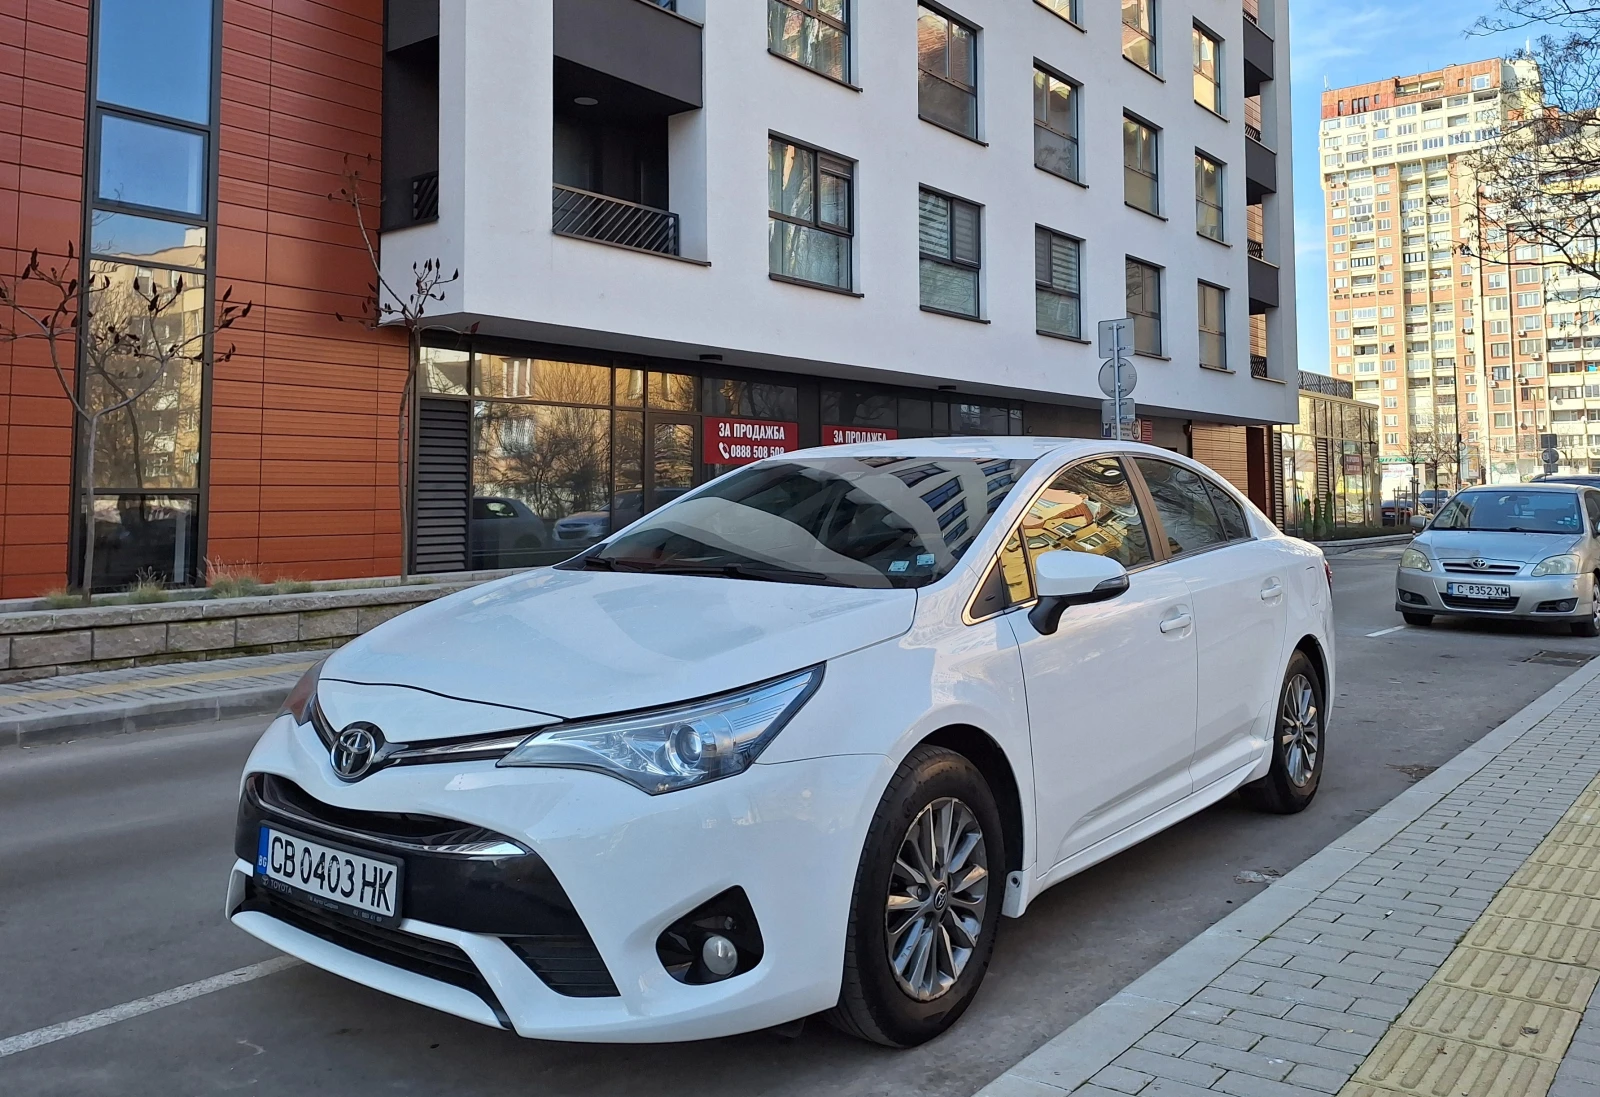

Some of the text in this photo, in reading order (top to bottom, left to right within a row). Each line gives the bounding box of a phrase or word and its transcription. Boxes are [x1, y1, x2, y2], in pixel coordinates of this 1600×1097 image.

[718, 422, 785, 441] ЗА ПРОДАЖБА
[833, 430, 887, 443] ЗА ПРОДАЖБА
[730, 444, 751, 458] 0888
[753, 445, 768, 459] 508
[258, 854, 267, 867] BG
[270, 879, 293, 895] TOYOTA
